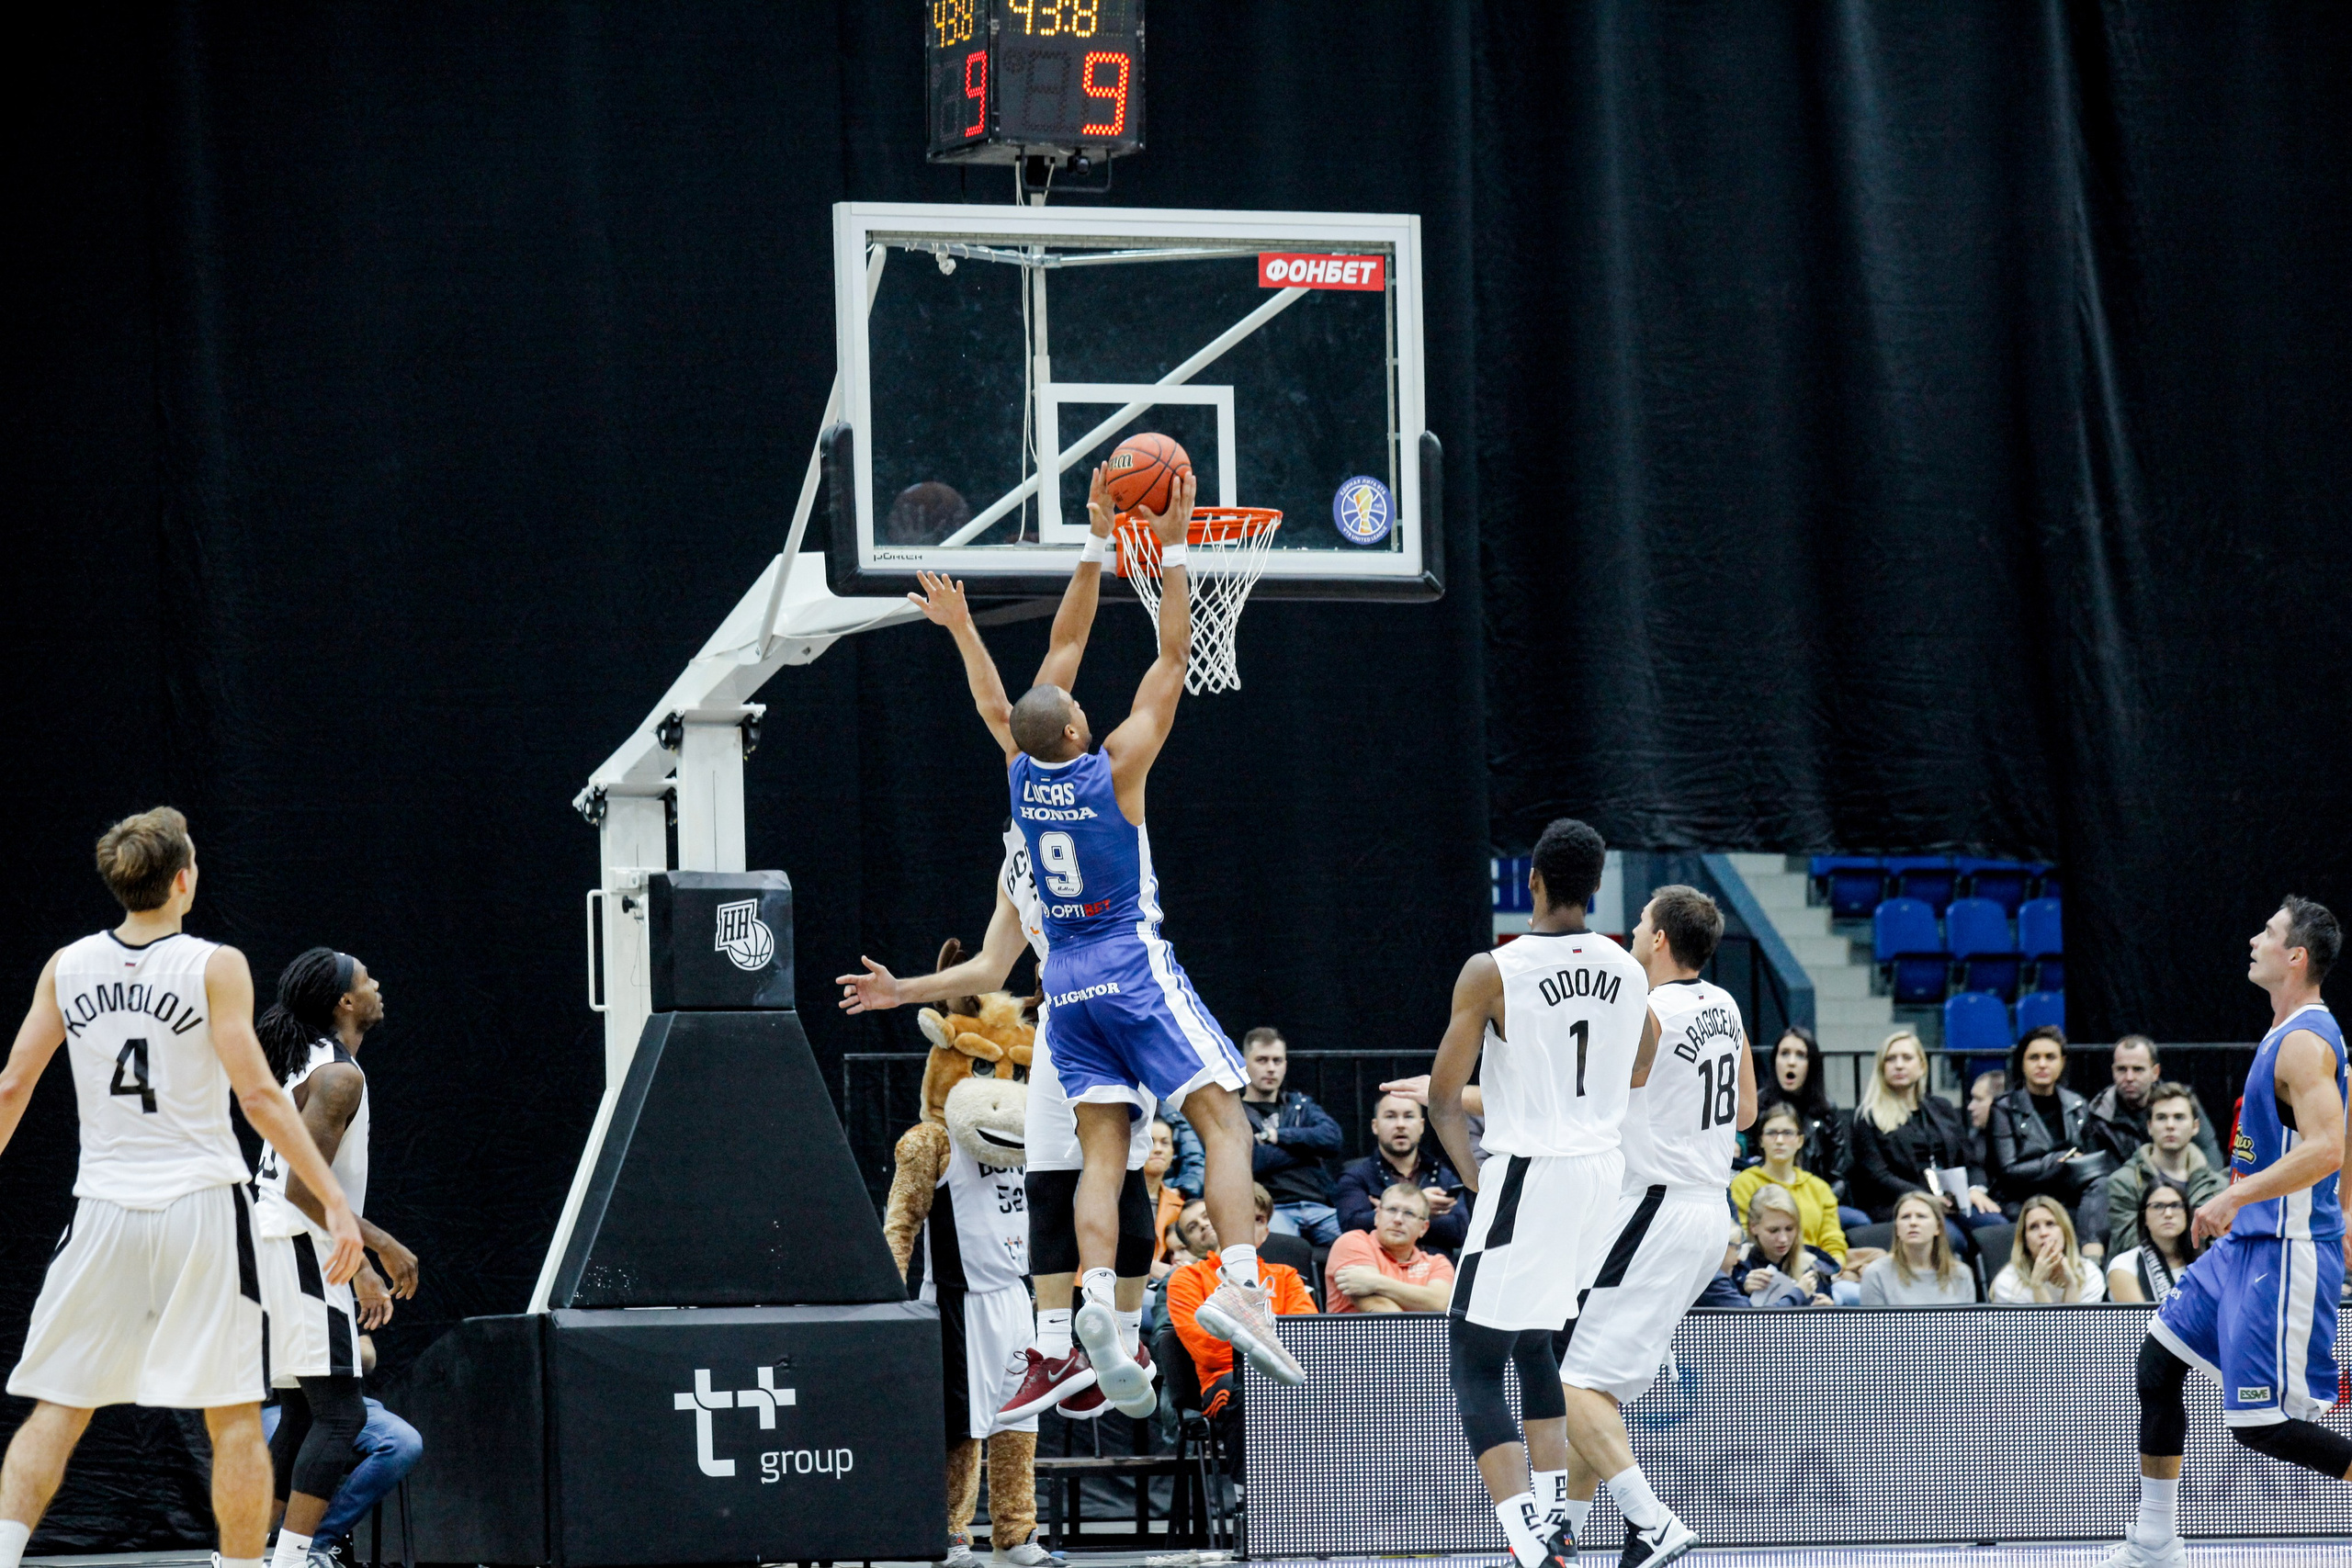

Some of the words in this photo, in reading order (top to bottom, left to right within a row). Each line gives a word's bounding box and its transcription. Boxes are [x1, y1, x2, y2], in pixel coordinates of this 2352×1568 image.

[965, 50, 988, 138] 9
[1082, 51, 1131, 136] 9
[1265, 258, 1377, 285] ФОНБЕТ
[1020, 807, 1098, 821] HONDA
[1023, 781, 1075, 806] LUCAS
[1039, 831, 1083, 897] 9
[1051, 898, 1111, 919] OPTIBET
[65, 982, 204, 1038] KOMOLOV
[1539, 968, 1622, 1007] ODOM
[110, 1038, 158, 1114] 4
[1569, 1020, 1589, 1098] 1
[1698, 1053, 1736, 1131] 18
[996, 1185, 1023, 1213] 52
[761, 1448, 854, 1484] group
